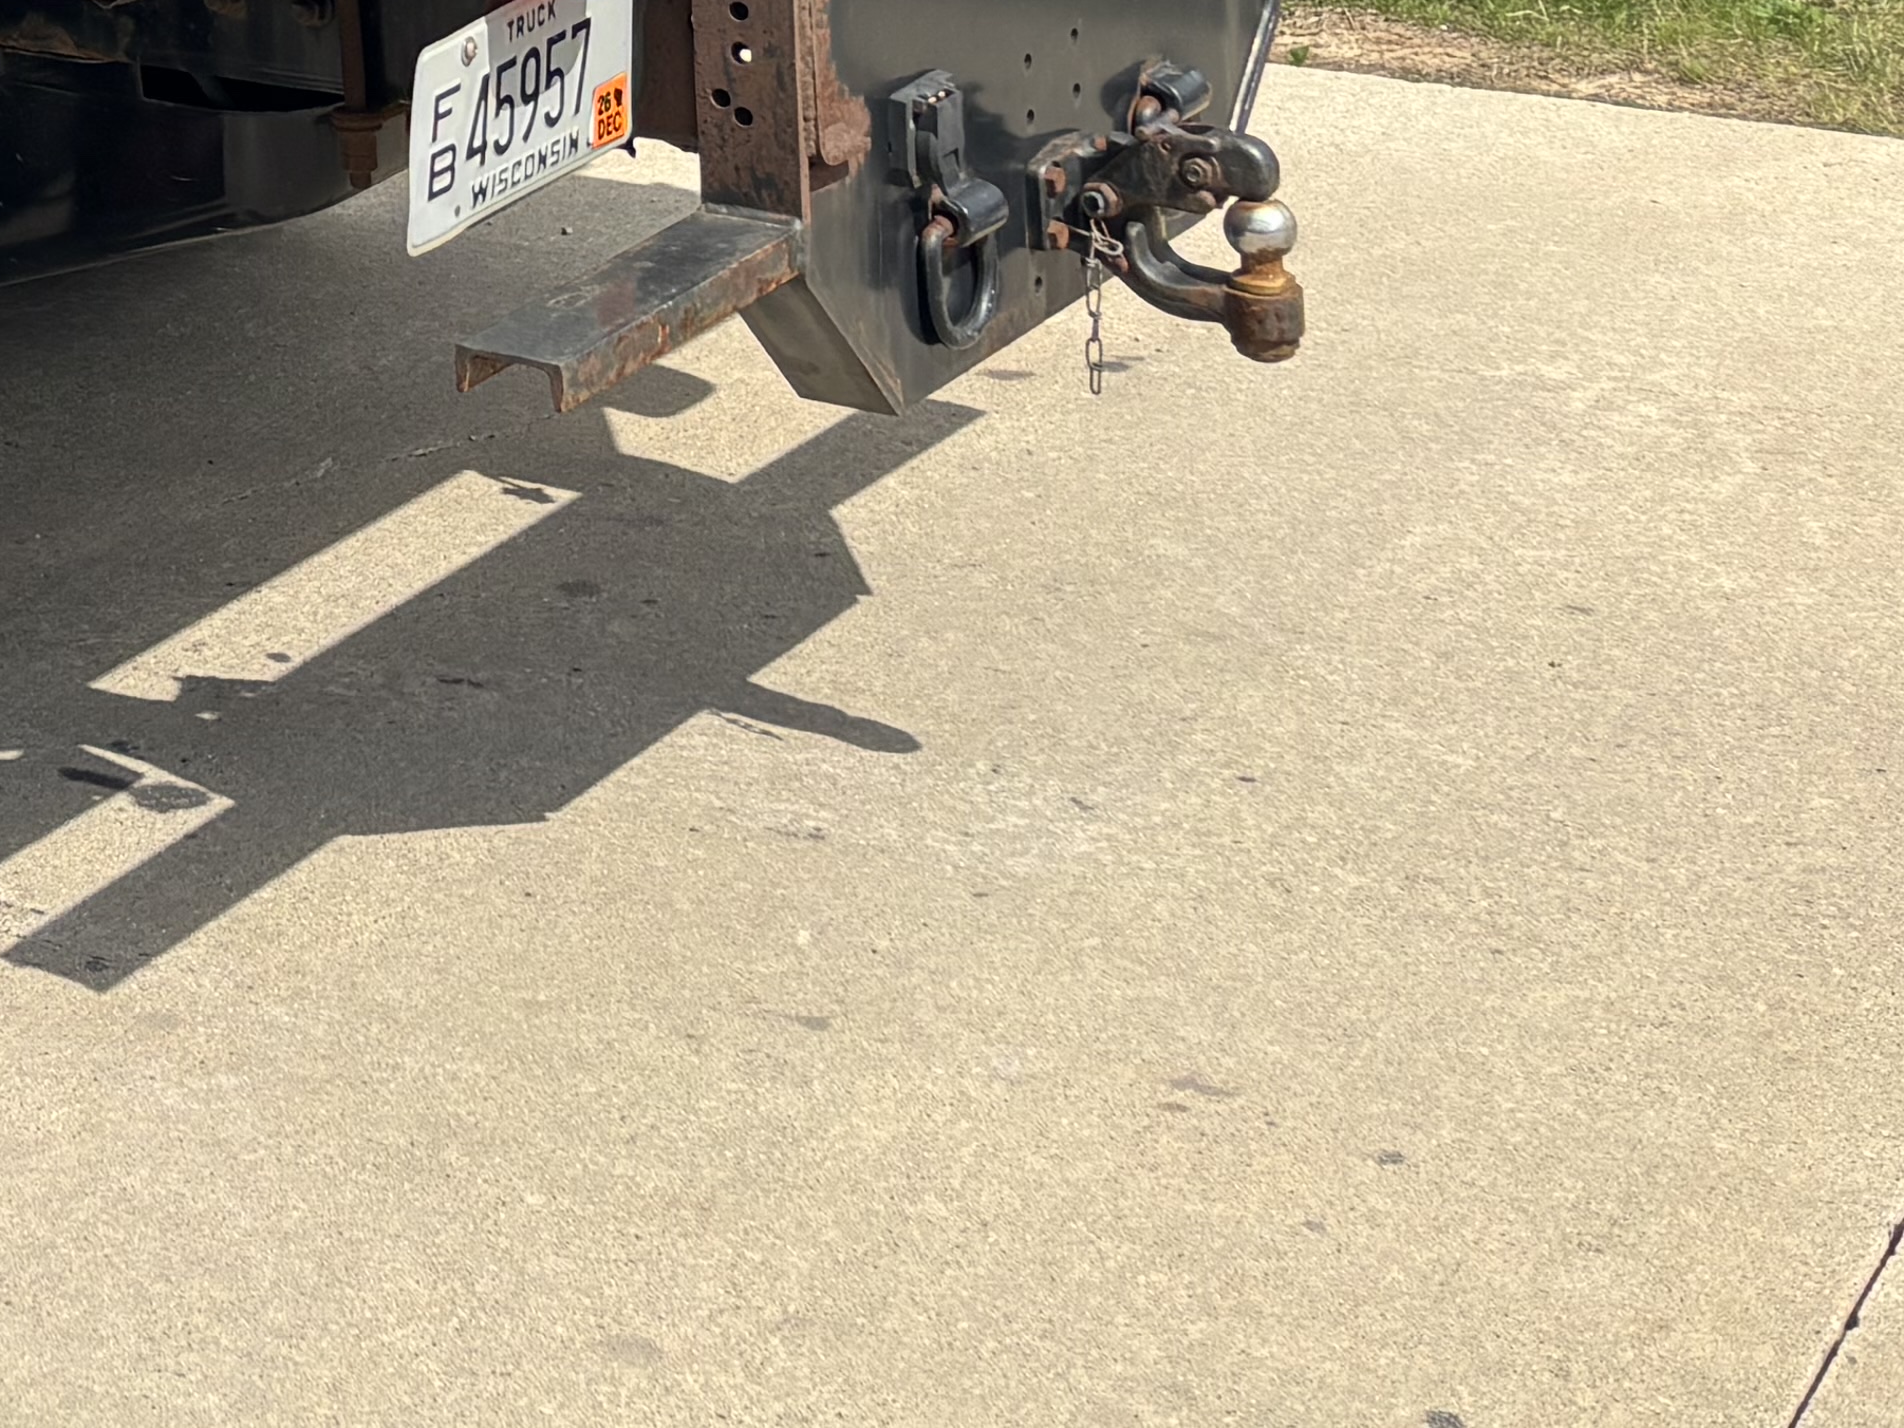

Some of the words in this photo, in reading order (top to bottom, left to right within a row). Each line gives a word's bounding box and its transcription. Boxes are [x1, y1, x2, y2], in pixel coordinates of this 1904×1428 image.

[465, 17, 592, 167] 45957
[597, 91, 612, 116] 26
[597, 110, 623, 141] DEC
[471, 129, 580, 209] WISCONSIN
